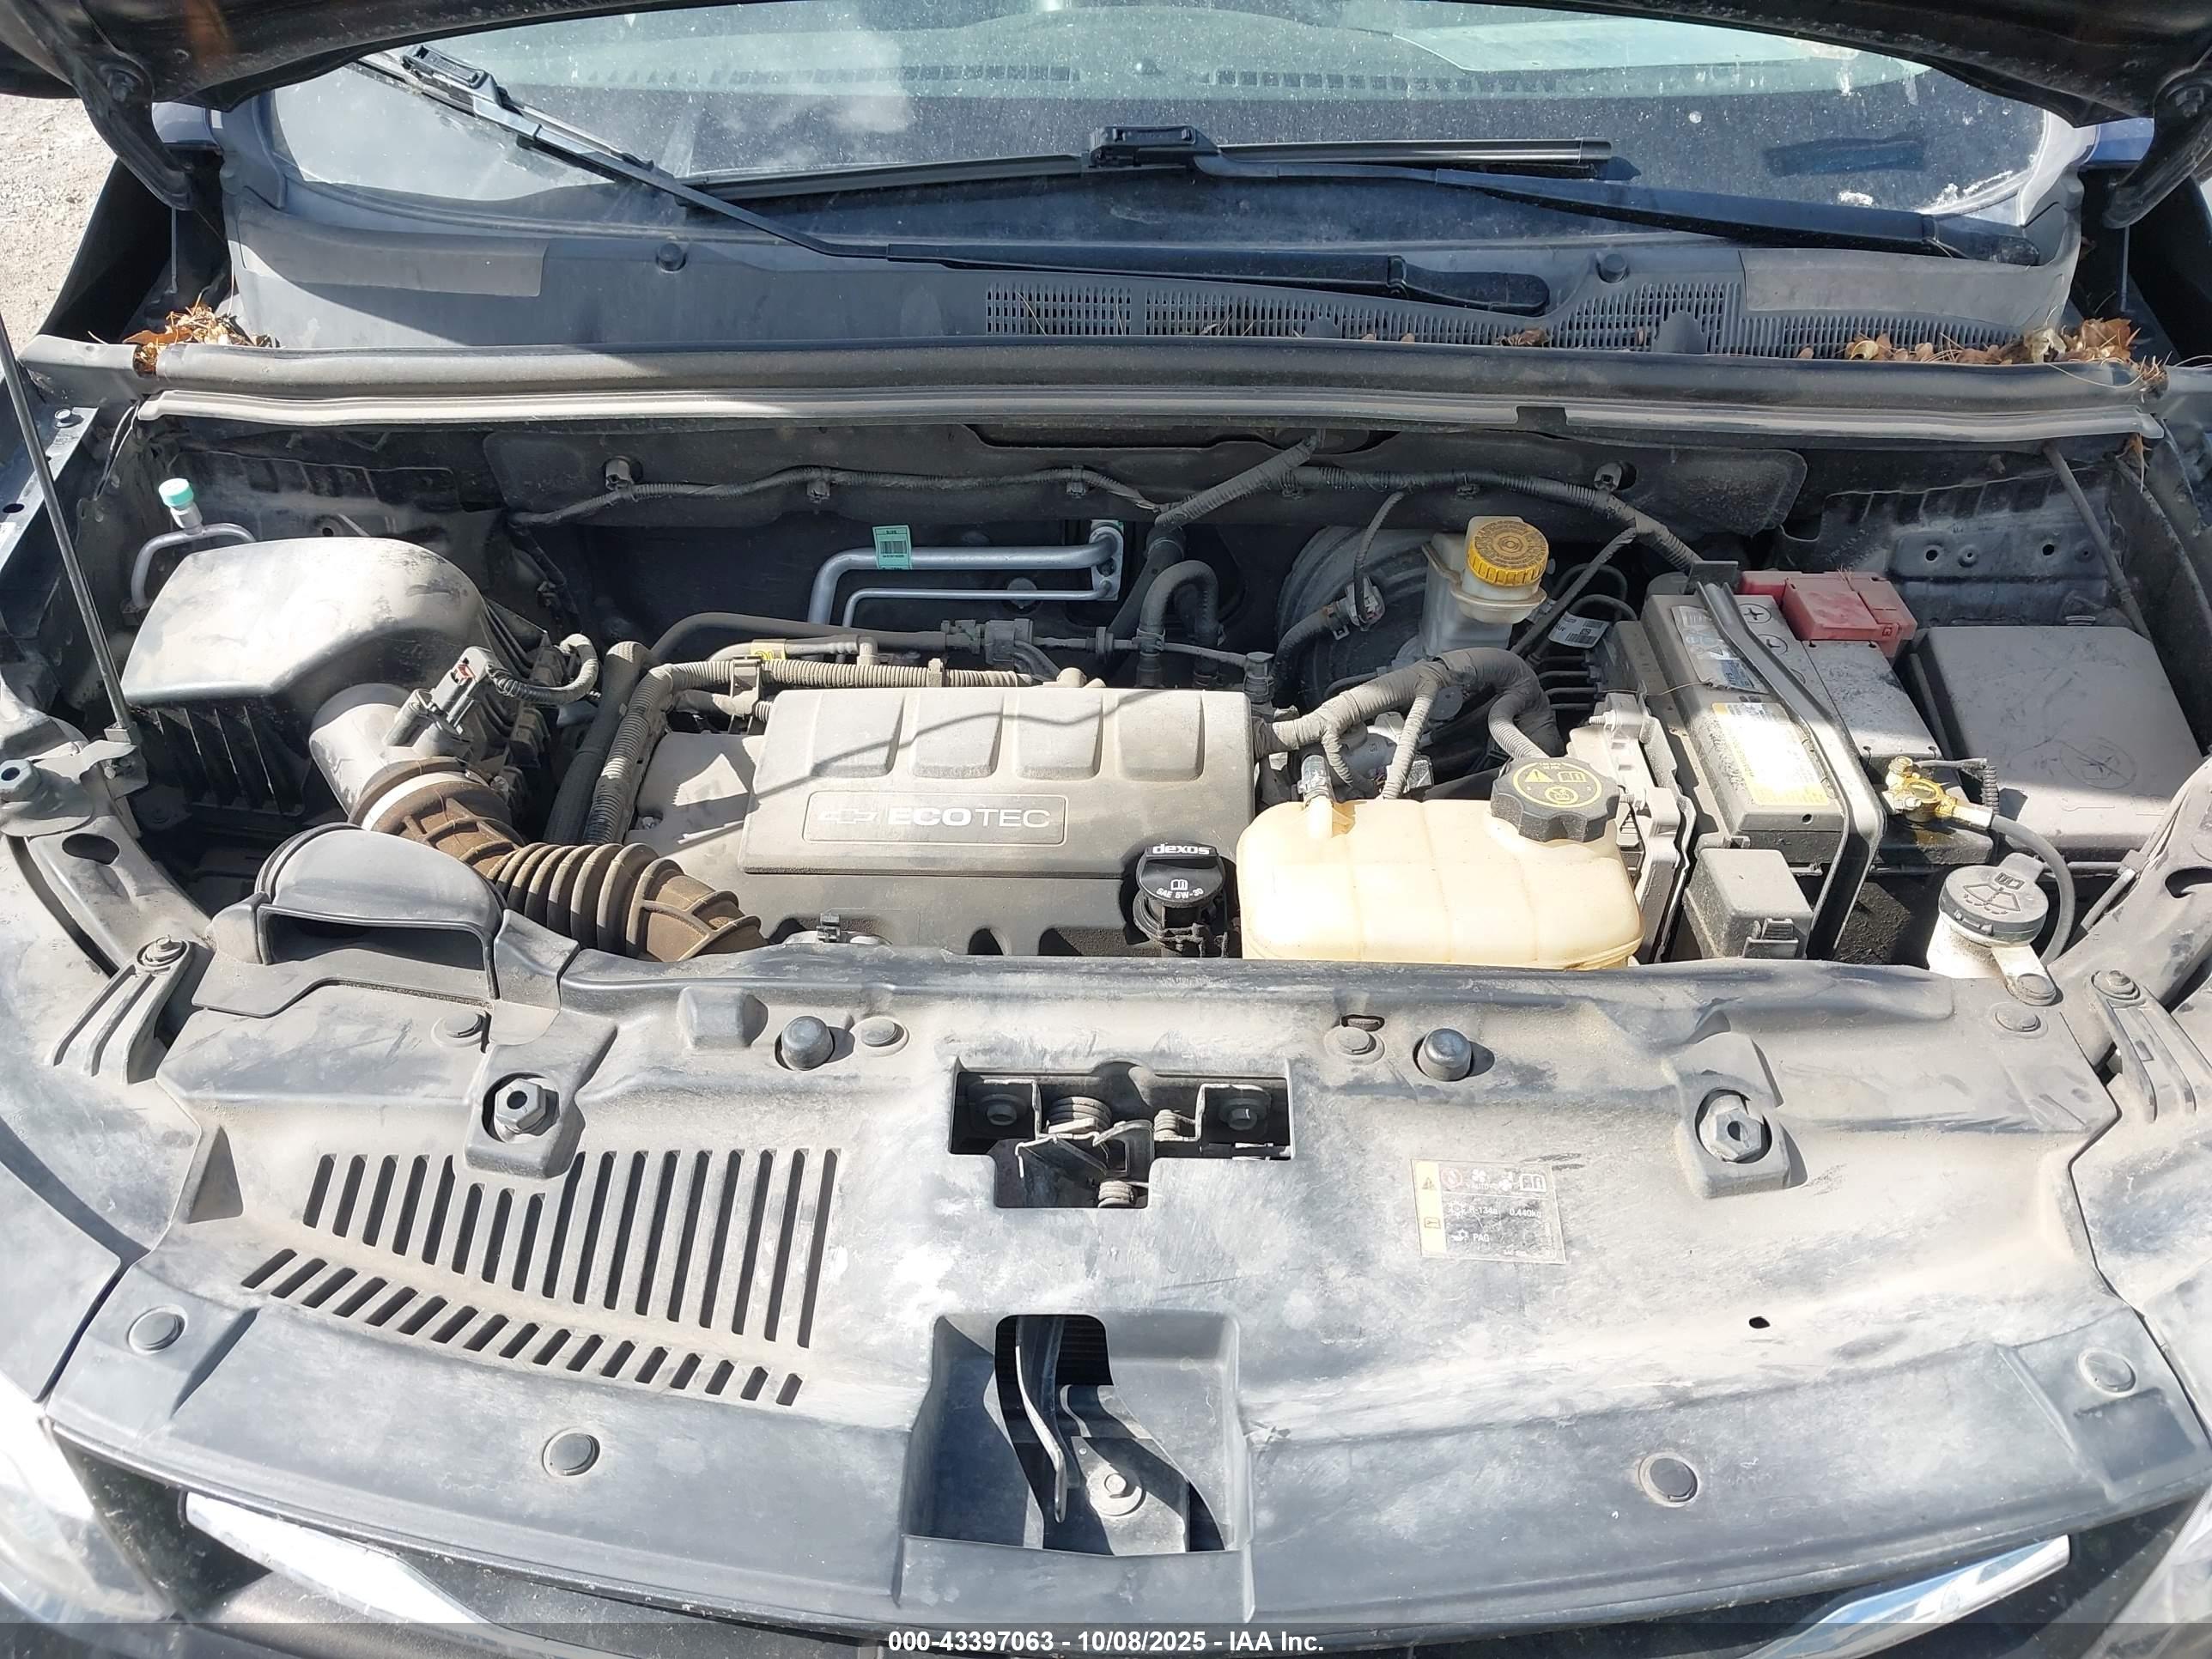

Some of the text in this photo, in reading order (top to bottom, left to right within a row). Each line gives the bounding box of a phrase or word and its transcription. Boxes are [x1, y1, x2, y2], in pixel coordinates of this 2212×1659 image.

[887, 807, 1051, 829] ECOTEC
[1152, 843, 1212, 856] dexos
[1156, 888, 1204, 899] SAE 5W-30
[1468, 1205, 1542, 1219] R-134a 0.440kg
[1473, 1232, 1490, 1243] PAG
